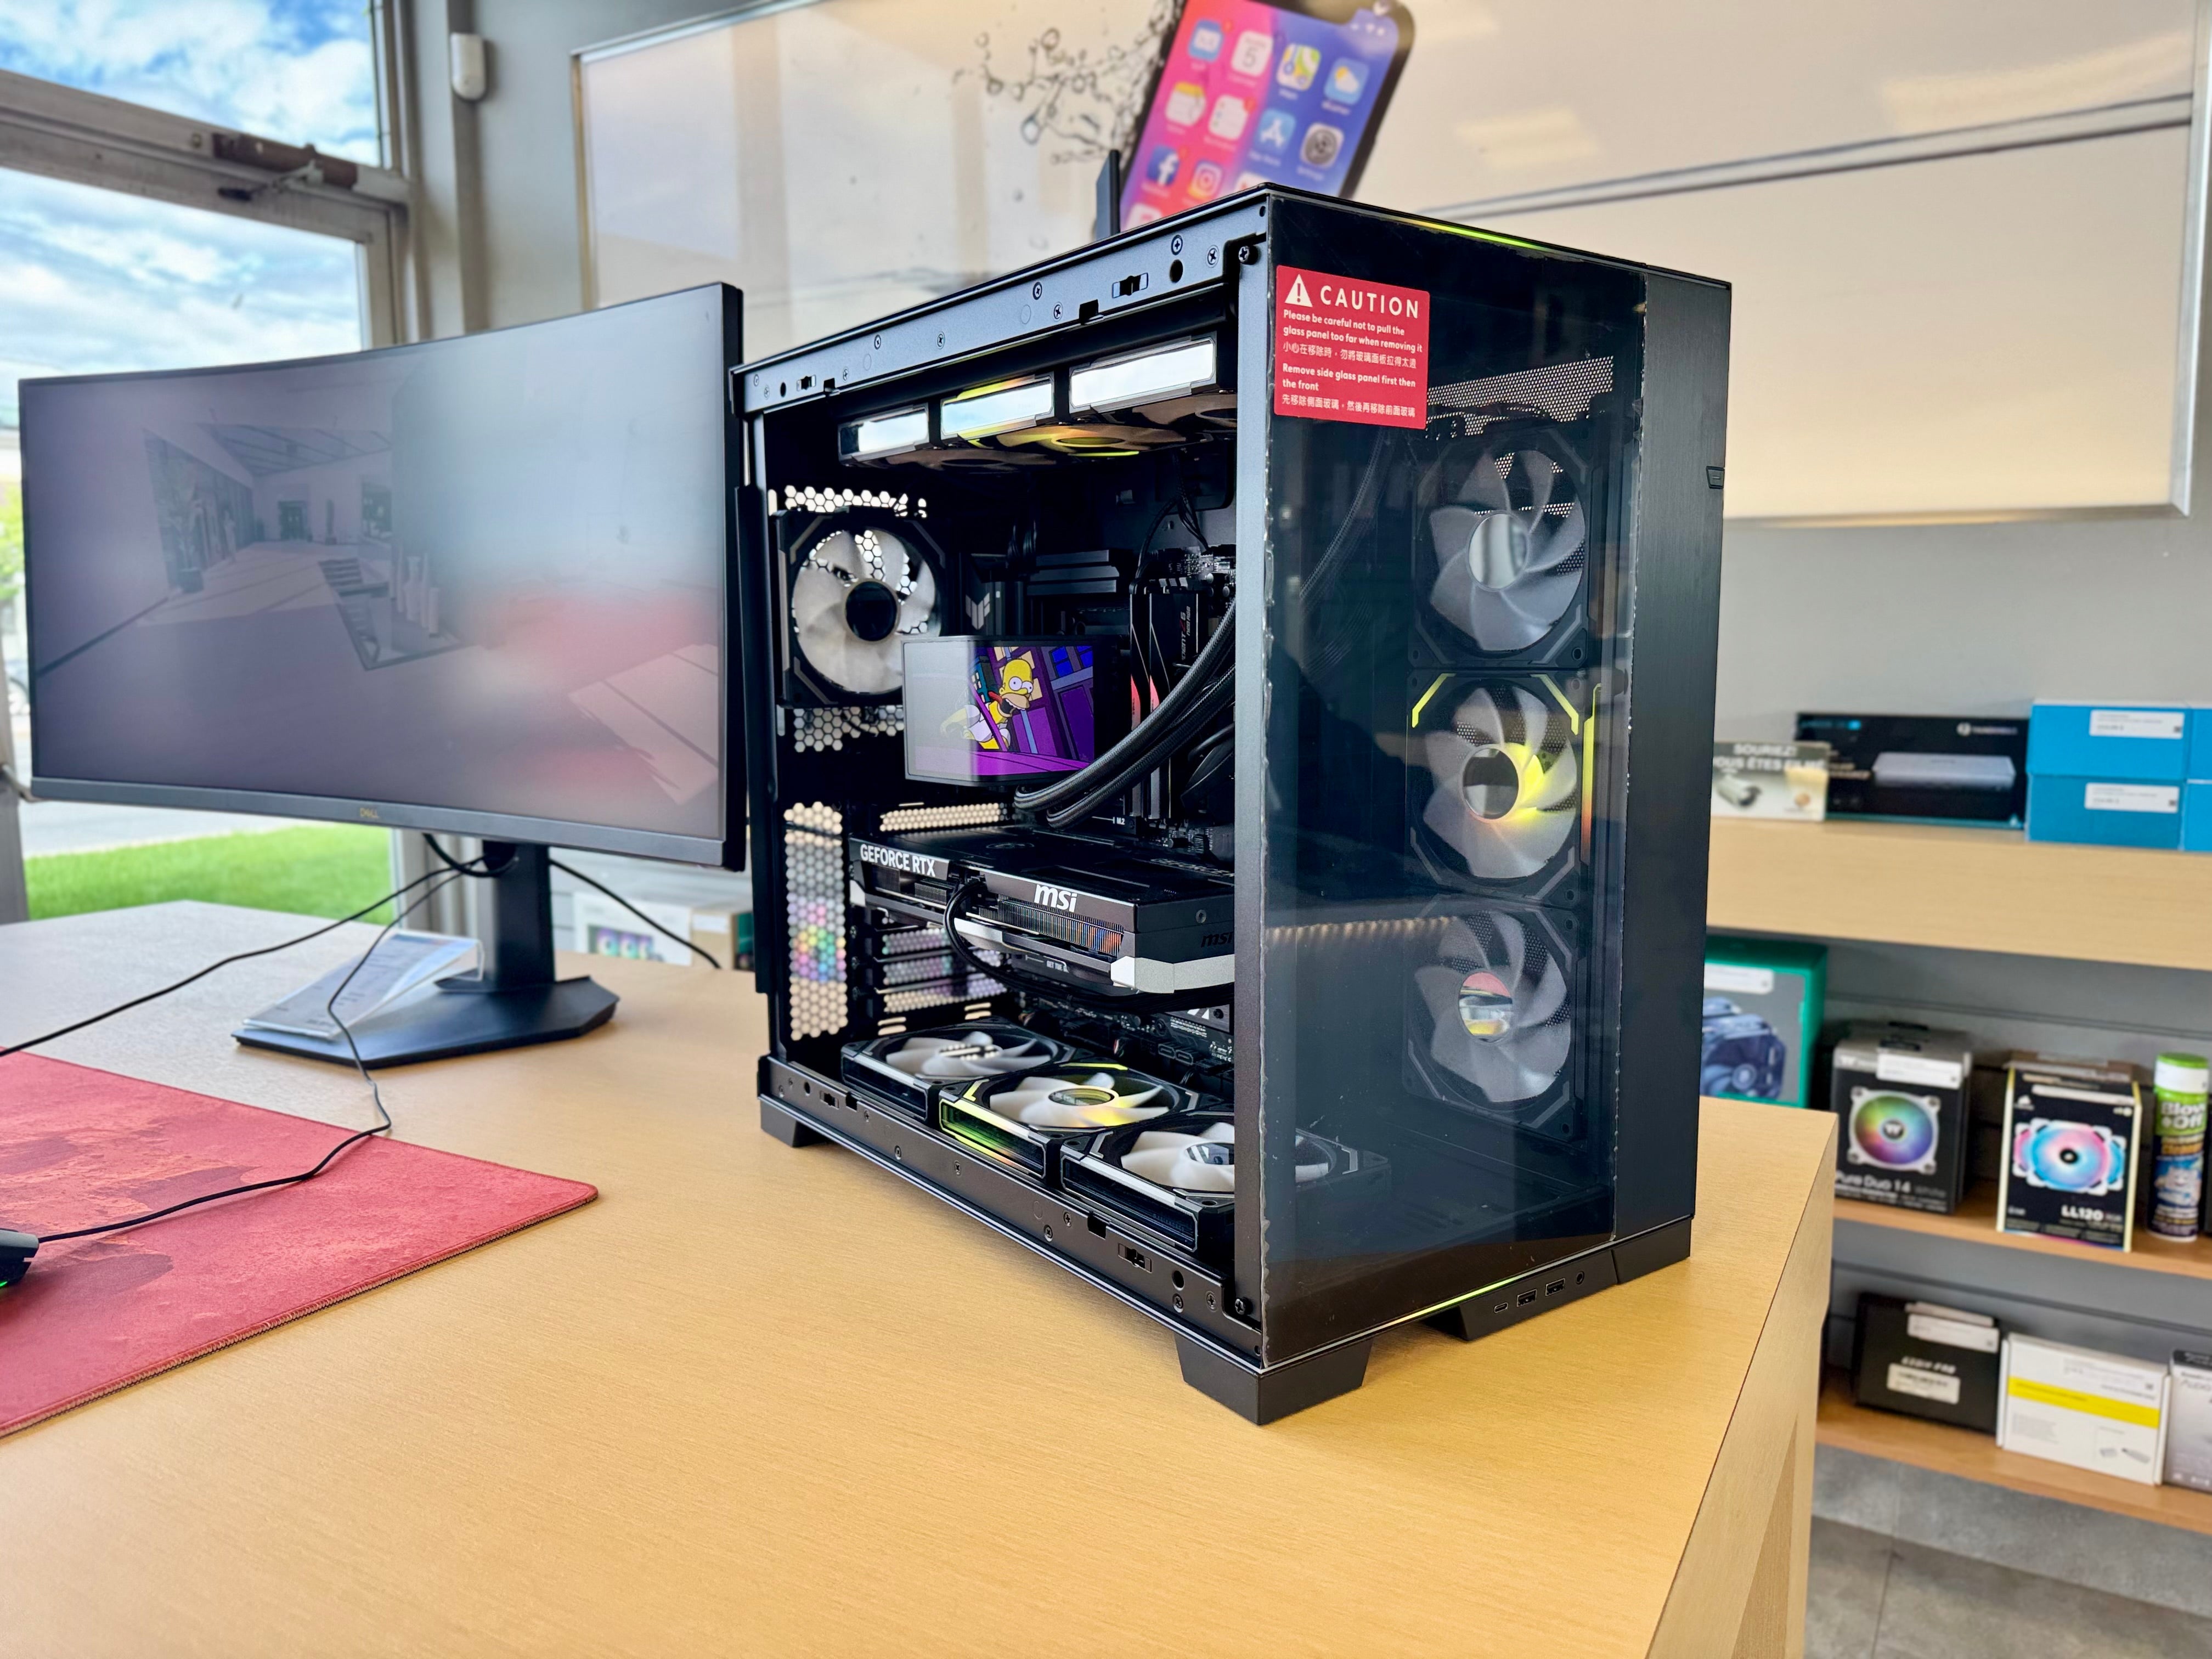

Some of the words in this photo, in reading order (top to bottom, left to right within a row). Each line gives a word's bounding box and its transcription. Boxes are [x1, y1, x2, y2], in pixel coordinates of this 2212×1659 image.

[1320, 285, 1418, 319] CAUTION
[1284, 309, 1311, 322] Please
[1312, 313, 1323, 323] be
[1324, 318, 1352, 328] careful
[1353, 321, 1366, 330] not
[1367, 323, 1375, 331] to
[1376, 325, 1391, 334] pull
[1392, 326, 1404, 335] the
[1283, 325, 1305, 336] glass
[1306, 330, 1329, 339] panel
[1330, 332, 1344, 341] too
[1345, 334, 1357, 343] far
[1358, 336, 1379, 347] when
[1380, 340, 1415, 354] removing
[1417, 343, 1423, 353] it
[1282, 379, 1296, 388] the
[1298, 380, 1319, 391] front
[1283, 363, 1315, 376] Remove
[1317, 368, 1334, 377] side
[1335, 370, 1356, 381] glass
[1357, 374, 1380, 383] panel
[1381, 375, 1397, 385] first
[1398, 377, 1416, 387] then
[359, 807, 380, 819] DELL
[860, 844, 911, 871] GEFORCE
[912, 855, 936, 877] RTX
[1034, 884, 1077, 913] msi
[1863, 1174, 1892, 1191] Duo
[1894, 1179, 1911, 1194] 14
[2061, 1204, 2104, 1221] LL120
